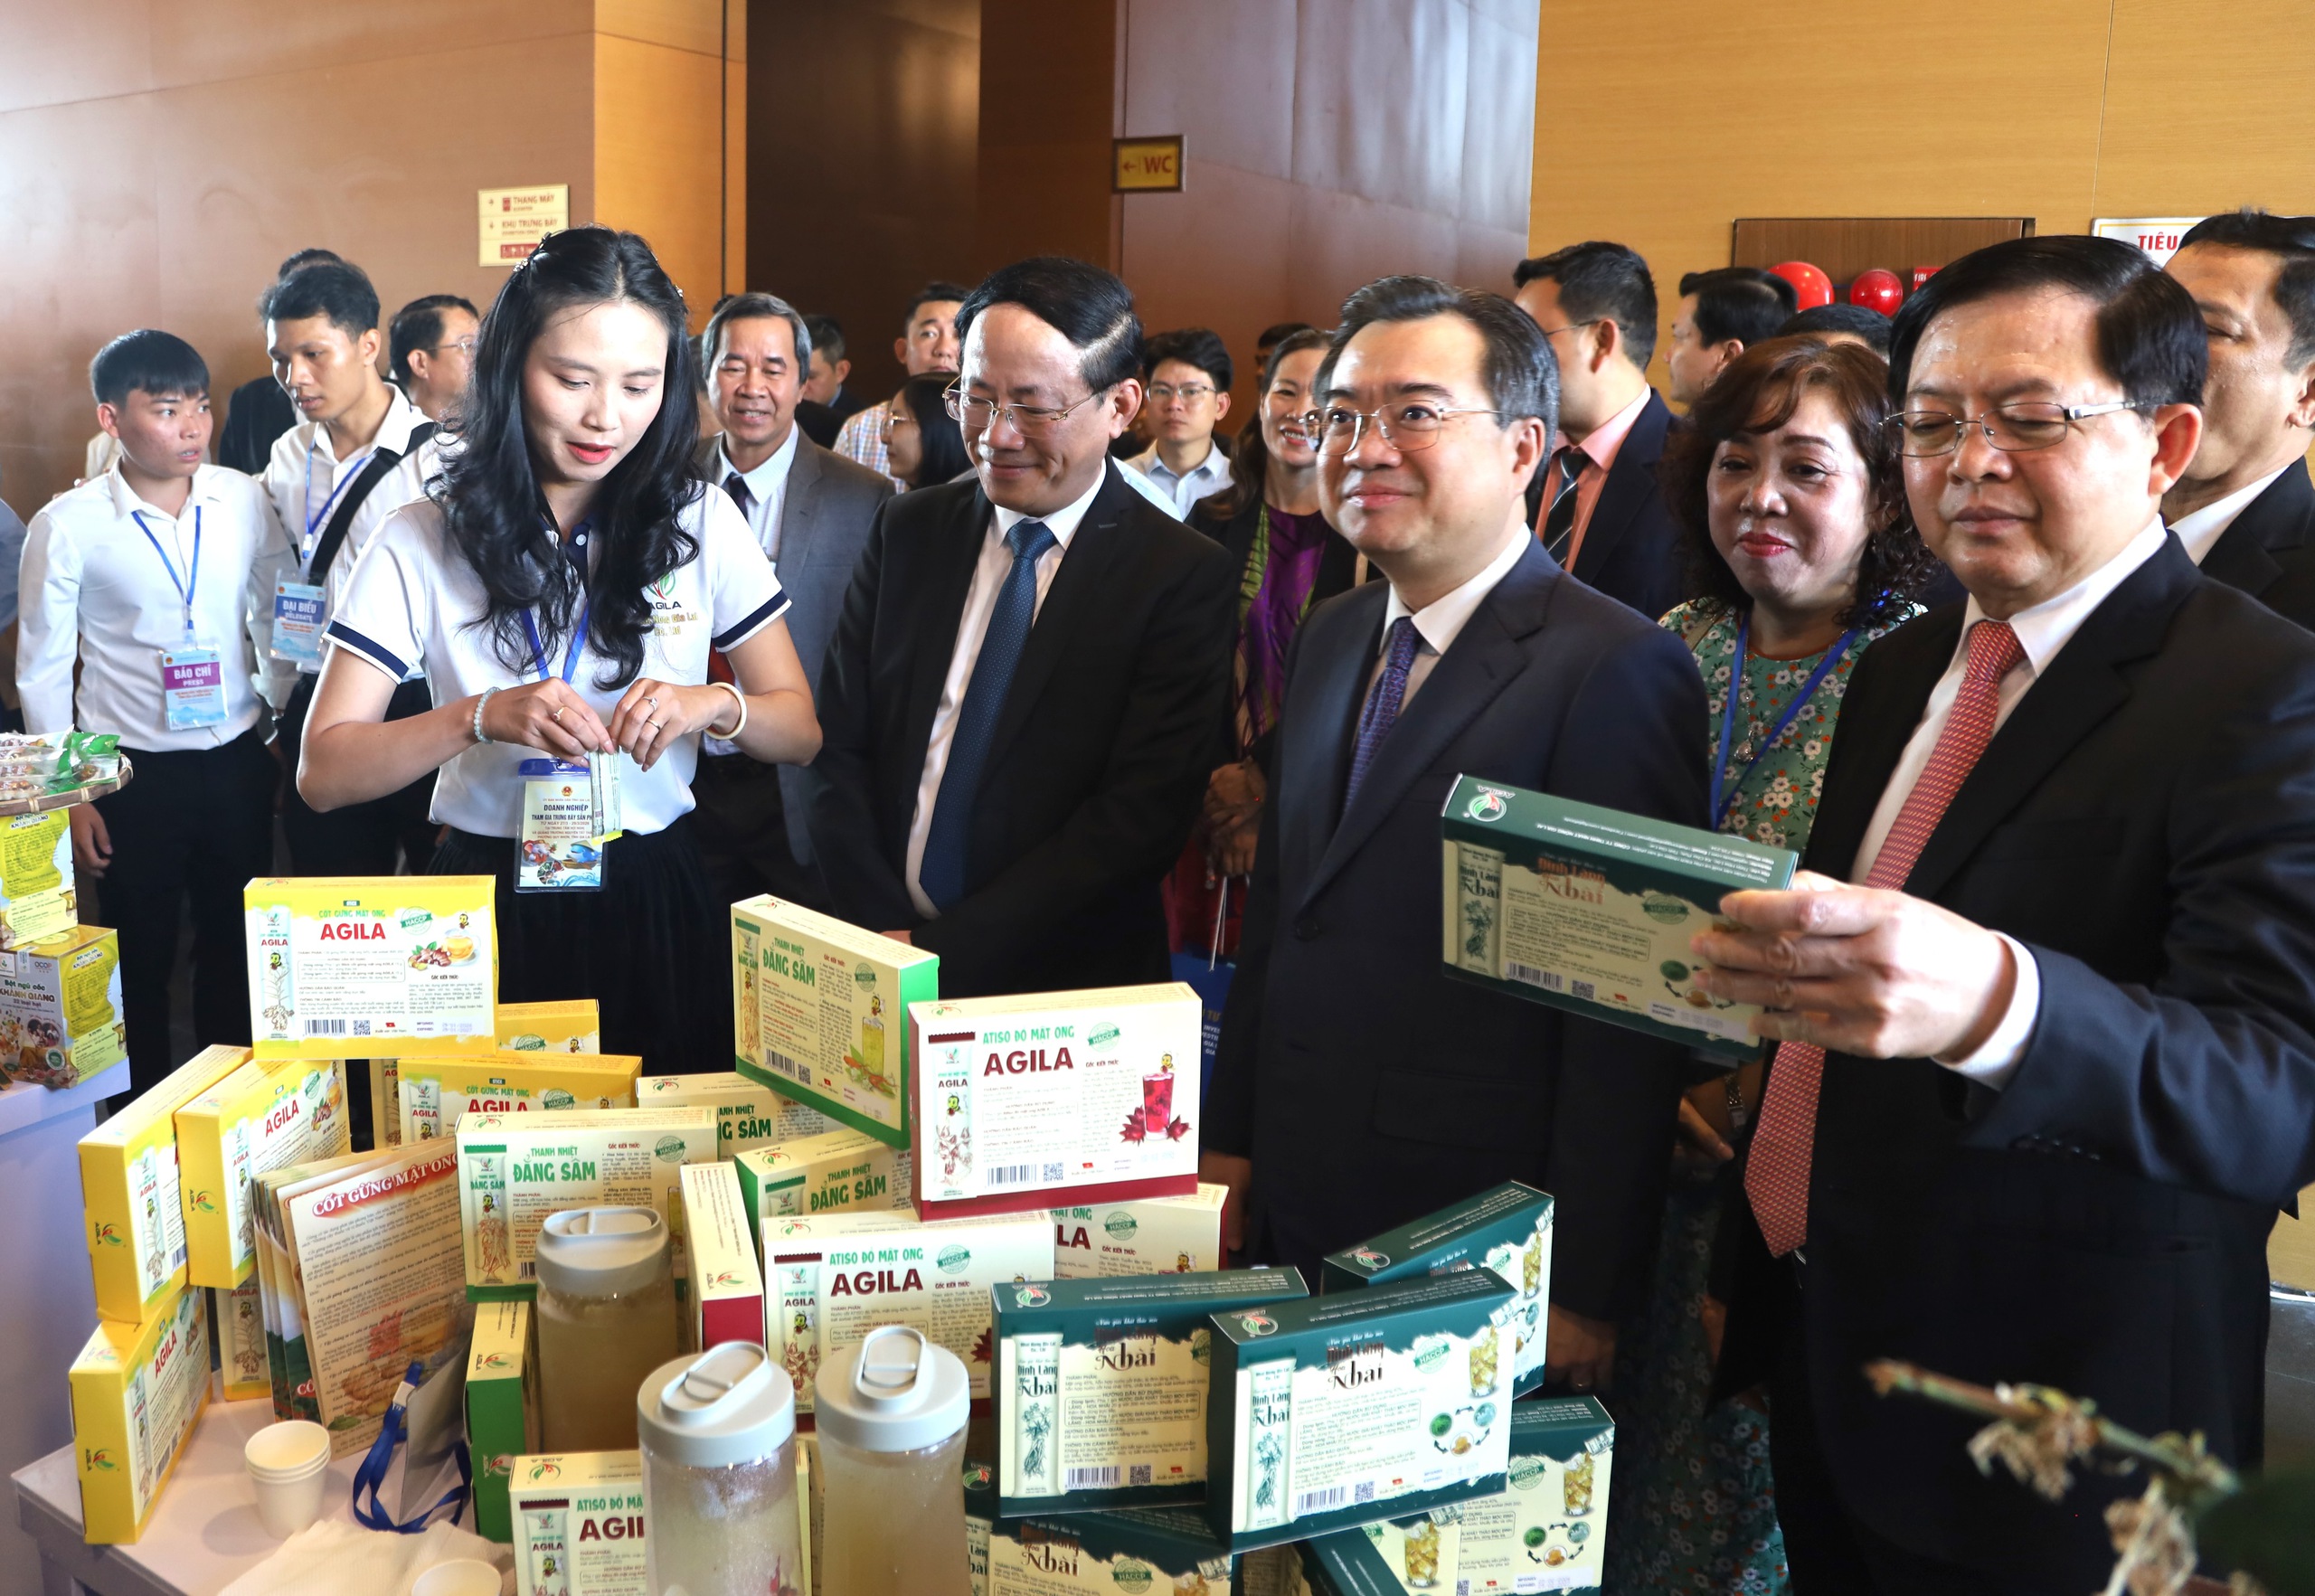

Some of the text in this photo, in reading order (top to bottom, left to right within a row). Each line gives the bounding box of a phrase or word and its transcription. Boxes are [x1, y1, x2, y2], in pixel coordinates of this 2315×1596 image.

[1144, 156, 1173, 174] WC
[513, 196, 538, 205] THANG
[502, 220, 517, 229] KHU
[2138, 231, 2178, 250] TIÊU
[174, 665, 212, 680] BÁO CHÍ
[183, 678, 204, 687] PRESS
[565, 803, 589, 812] NGHIỆP
[372, 909, 386, 918] ONG
[404, 914, 429, 928] HACCP
[320, 922, 386, 940] AGILA
[260, 939, 288, 947] AGILA
[774, 937, 790, 952] THANH
[34, 960, 52, 969] OCOP
[792, 959, 816, 987] SÂM
[982, 1031, 1011, 1045] ATISO
[1054, 1025, 1074, 1039] ONG
[1092, 1031, 1117, 1044] HACCP
[983, 1047, 1074, 1077] AGILA
[938, 1078, 969, 1088] AGILA
[515, 1088, 531, 1098] ONG
[468, 1099, 528, 1113] AGILA
[548, 1097, 570, 1108] HACCP
[412, 1110, 438, 1119] AGILA
[719, 1104, 755, 1117] ANH NHIỆT
[265, 1099, 300, 1138] AGILA
[738, 1117, 771, 1138] SÂM
[530, 1145, 578, 1158] THANH NHIỆT
[660, 1144, 680, 1155] HACCP
[232, 1150, 250, 1167] AGILA
[561, 1157, 596, 1181] SÂM
[827, 1163, 871, 1181] THANH NHIỆT
[139, 1180, 156, 1198] AGILA
[313, 1192, 345, 1215] CỐT
[348, 1177, 392, 1203] GỪNG
[395, 1165, 428, 1186] MẬT
[854, 1175, 886, 1201] SÂM
[1072, 1207, 1092, 1221] ONG
[1109, 1222, 1133, 1231] HACCP
[1101, 1245, 1111, 1253] GÓC
[829, 1247, 924, 1266] ATISO ĐỎ MẬT ONG
[941, 1252, 965, 1266] HACCP
[830, 1268, 924, 1297] AGILA
[935, 1281, 945, 1289] GÓC
[231, 1288, 259, 1298] AGILA
[784, 1298, 816, 1308] AGILA
[155, 1329, 178, 1379] AGILA
[1094, 1342, 1157, 1372] Nhài
[1420, 1346, 1445, 1365] HACCP
[1328, 1360, 1383, 1390] Nhài
[1515, 1468, 1541, 1480] HACCP
[576, 1498, 607, 1513] ATISO
[609, 1493, 624, 1509] ĐỎ
[532, 1542, 564, 1552] AGILA
[1021, 1545, 1080, 1577] Nhài
[1118, 1572, 1146, 1581] HACCP
